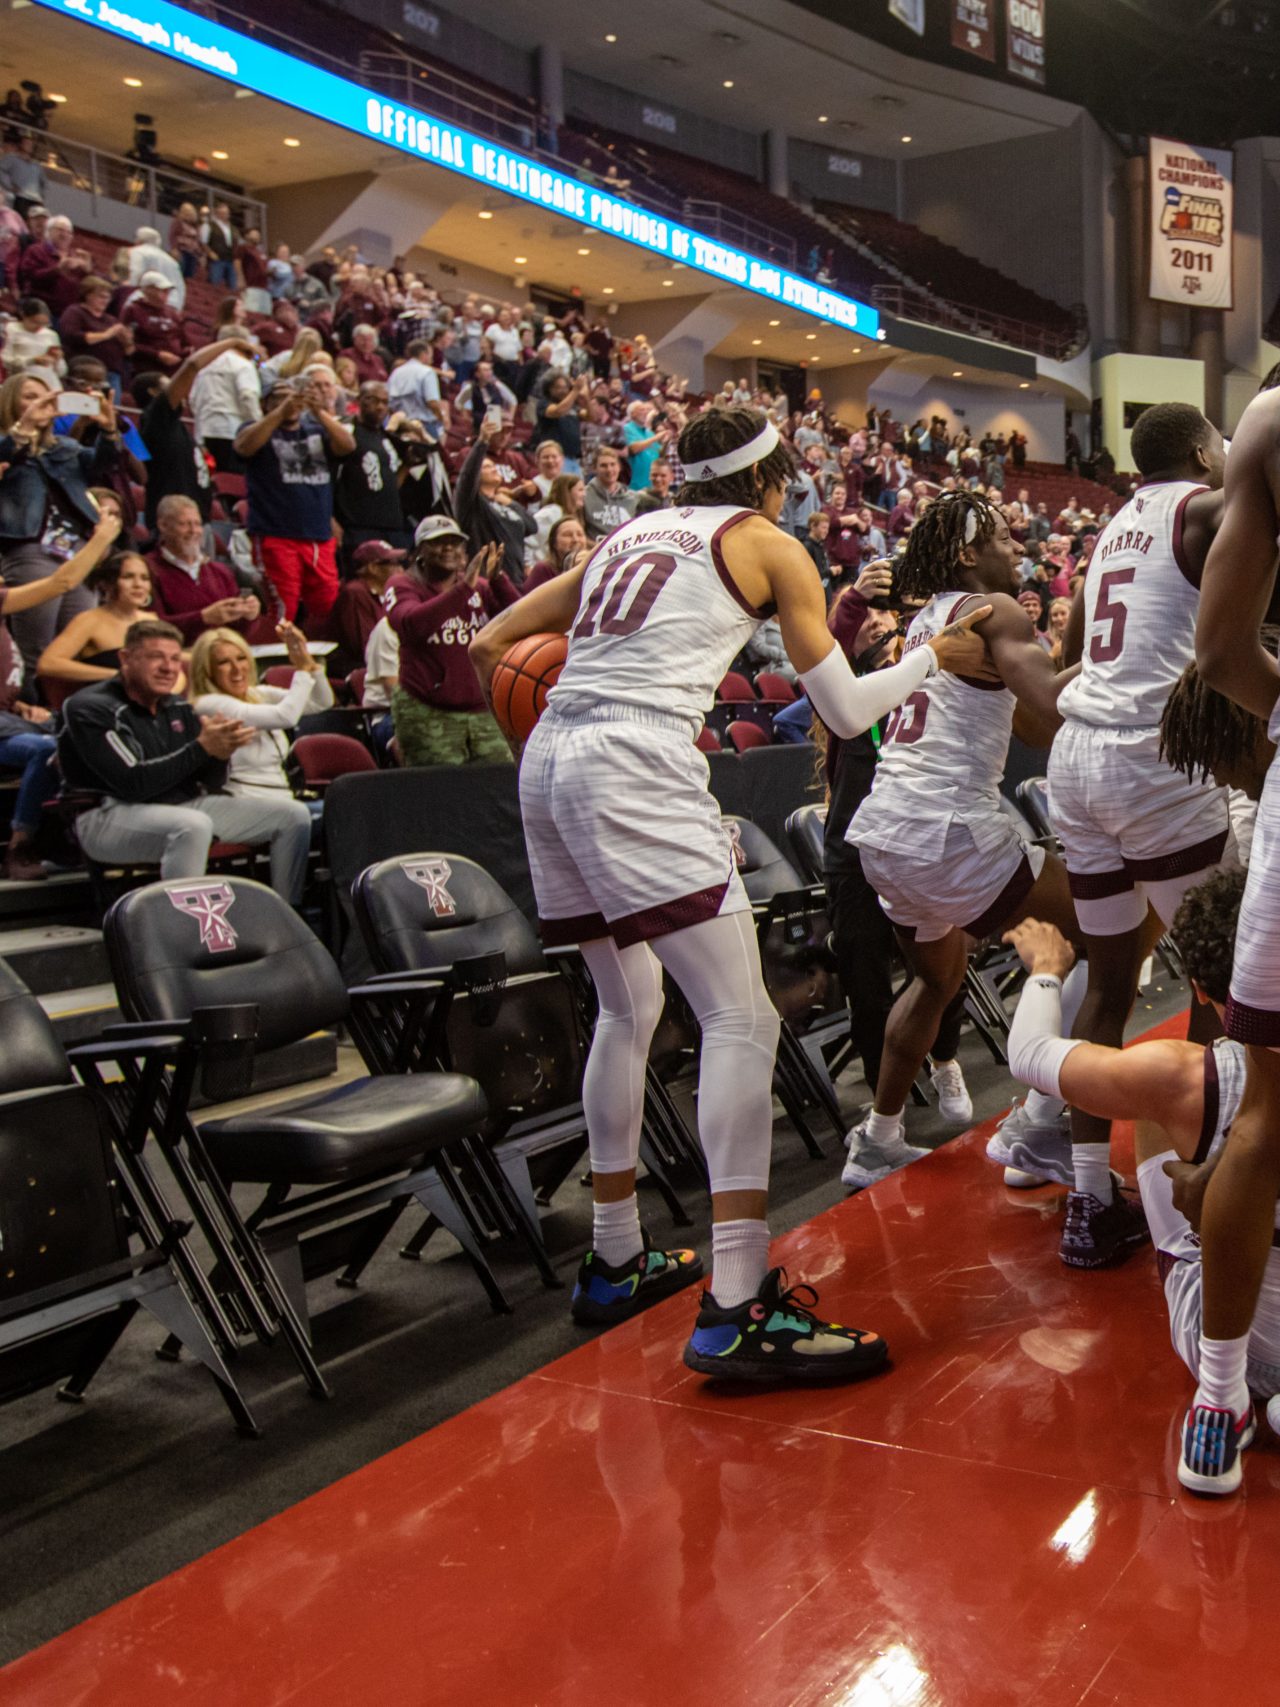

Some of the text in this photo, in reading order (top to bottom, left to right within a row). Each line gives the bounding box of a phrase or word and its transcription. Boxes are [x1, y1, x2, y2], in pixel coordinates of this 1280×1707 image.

[1166, 154, 1217, 174] NATIONAL
[1158, 168, 1224, 191] CHAMPIONS
[367, 99, 464, 167] OFFICIAL
[473, 144, 584, 217] HEALTHCARE
[591, 195, 667, 249] PROVIDER
[672, 230, 689, 258] OF
[692, 238, 747, 282] TEXAS
[783, 277, 857, 326] ATHLETICS
[1171, 248, 1213, 273] 2011
[608, 530, 704, 556] HENDERSON
[1101, 531, 1154, 560] DIARRA
[574, 553, 678, 638] 10
[1090, 567, 1136, 664] 5
[427, 629, 477, 645] AGGI
